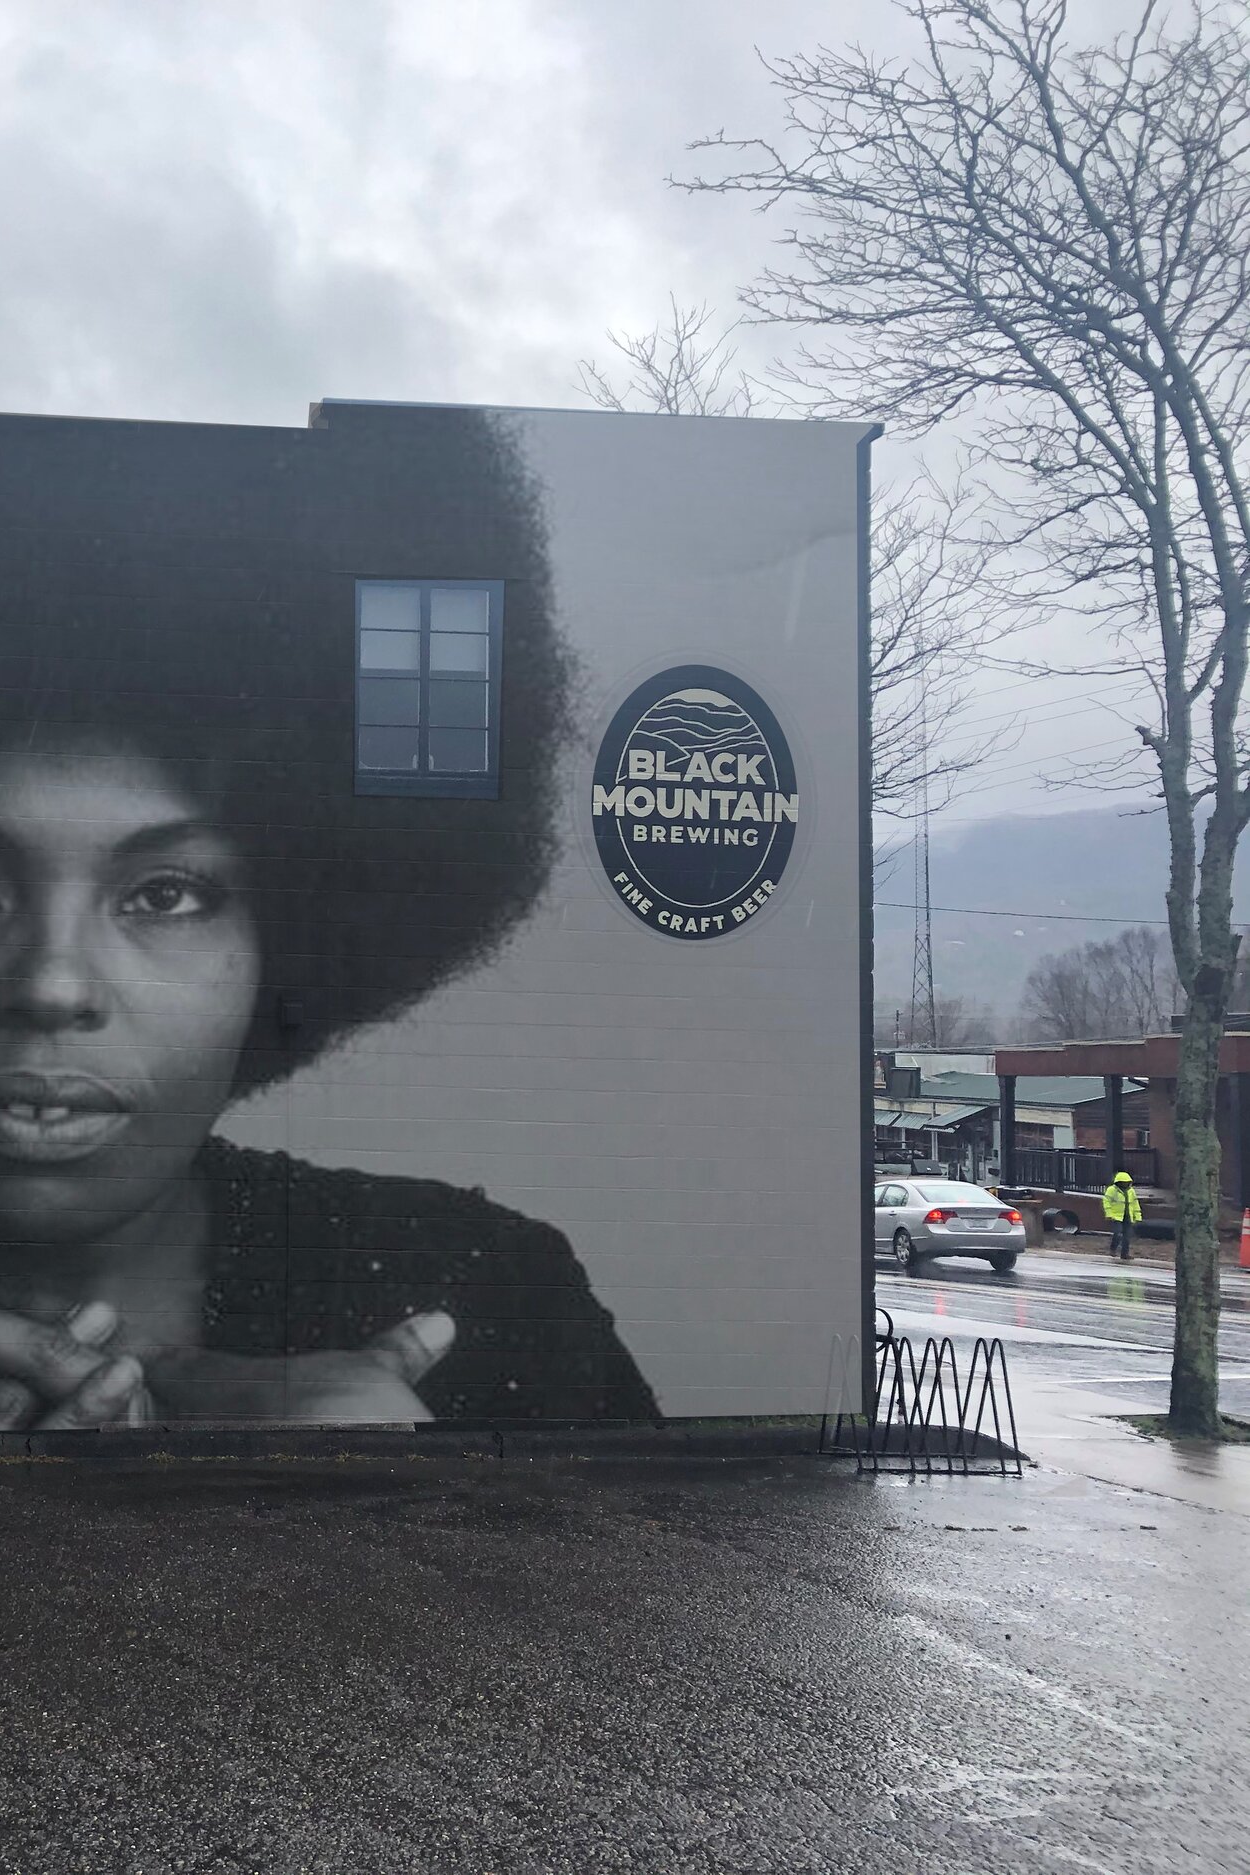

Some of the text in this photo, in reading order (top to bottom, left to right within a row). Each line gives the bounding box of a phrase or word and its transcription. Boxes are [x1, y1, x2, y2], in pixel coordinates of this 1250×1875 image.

[629, 749, 766, 785] BLACK
[592, 784, 799, 822] MOUNTAIN
[633, 825, 759, 846] BREWING
[613, 871, 777, 932] FINE CRAFT BEER
